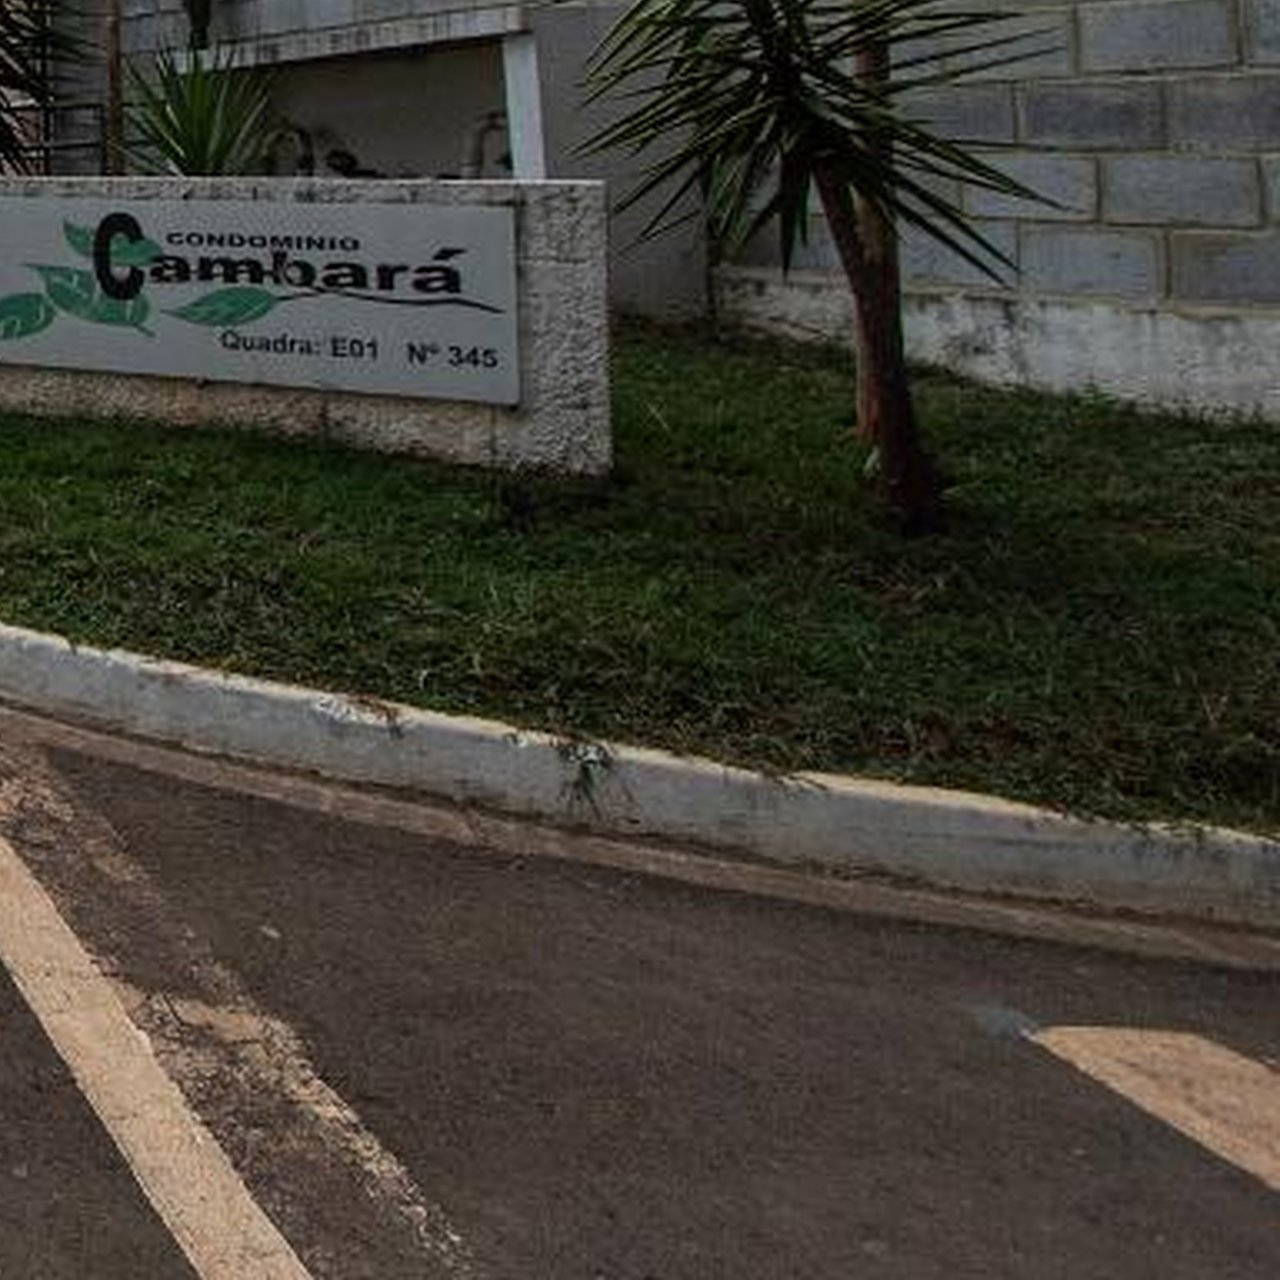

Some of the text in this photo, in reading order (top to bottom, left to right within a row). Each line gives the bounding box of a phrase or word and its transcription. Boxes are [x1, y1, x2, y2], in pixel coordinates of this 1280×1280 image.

[92, 212, 468, 300] Cambará
[165, 231, 361, 252] CONDOMINIO
[220, 330, 322, 357] Quadra:
[331, 338, 378, 360] E01
[447, 346, 499, 369] 345
